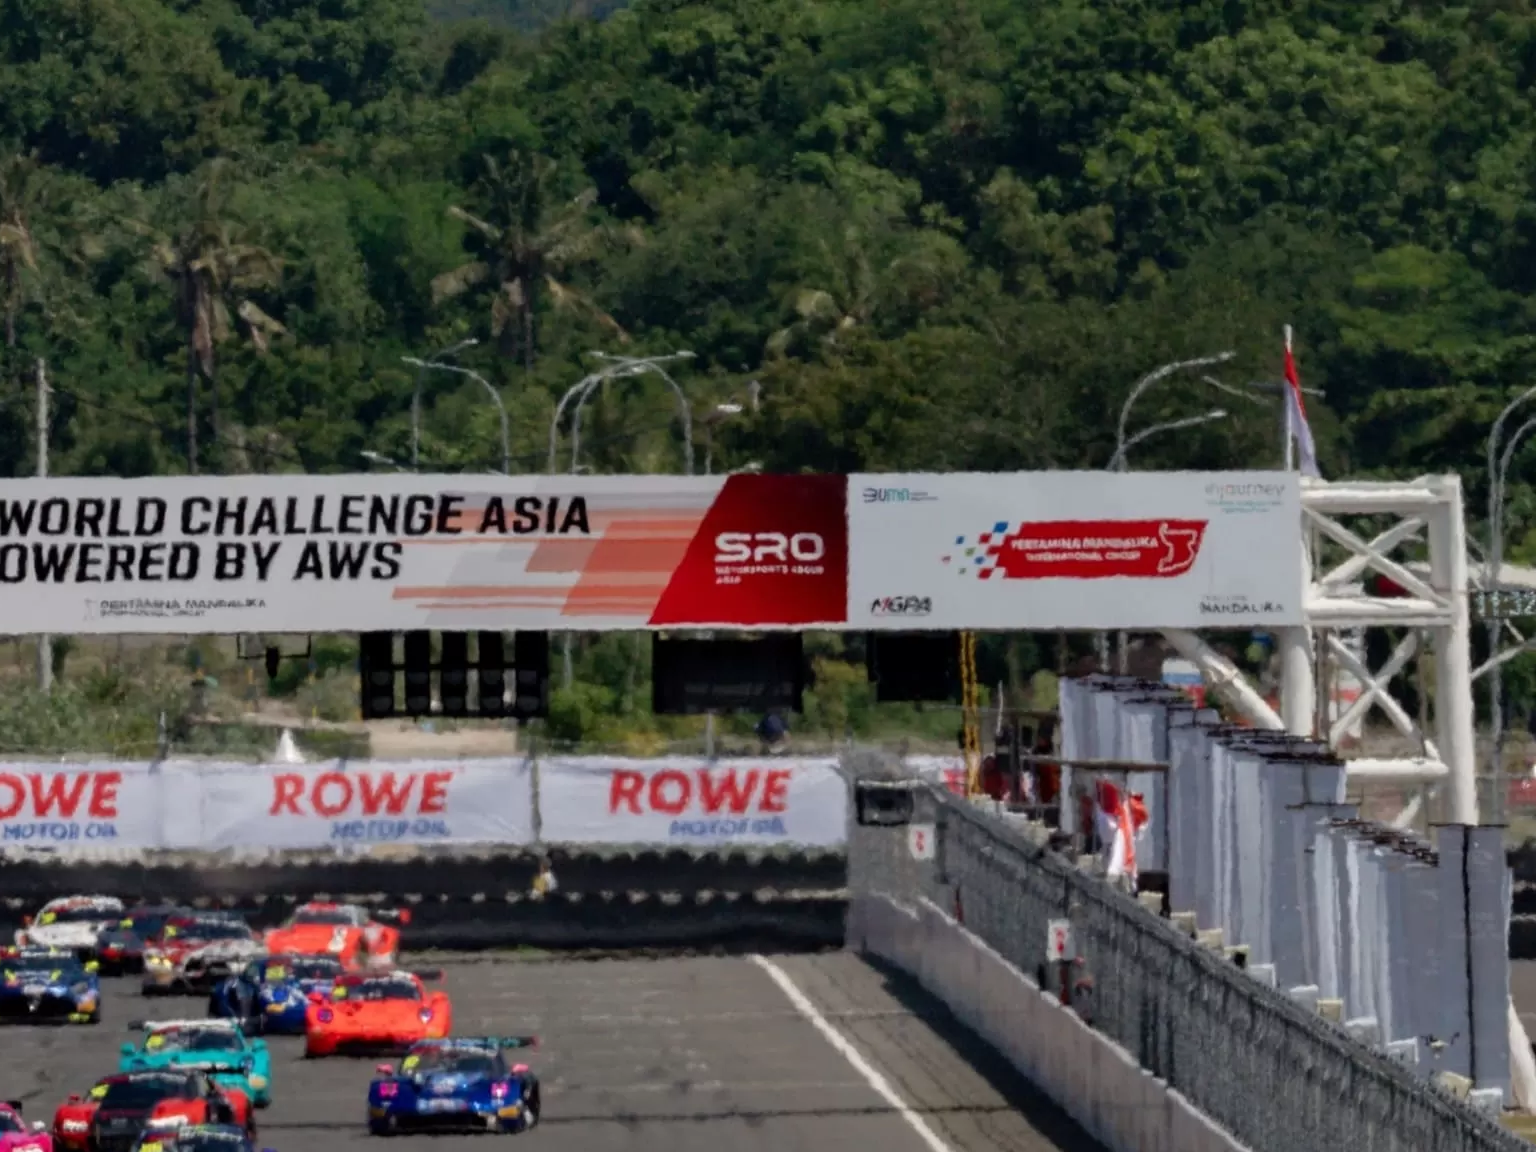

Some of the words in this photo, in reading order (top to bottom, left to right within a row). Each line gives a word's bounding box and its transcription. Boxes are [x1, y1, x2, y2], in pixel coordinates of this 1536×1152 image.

[181, 496, 464, 535] CHALLENGE
[479, 496, 591, 534] ASIA
[214, 541, 281, 580] BY
[293, 541, 403, 580] AWS
[714, 532, 824, 562] SRO
[268, 771, 453, 817] ROWE
[609, 768, 792, 816] ROWE
